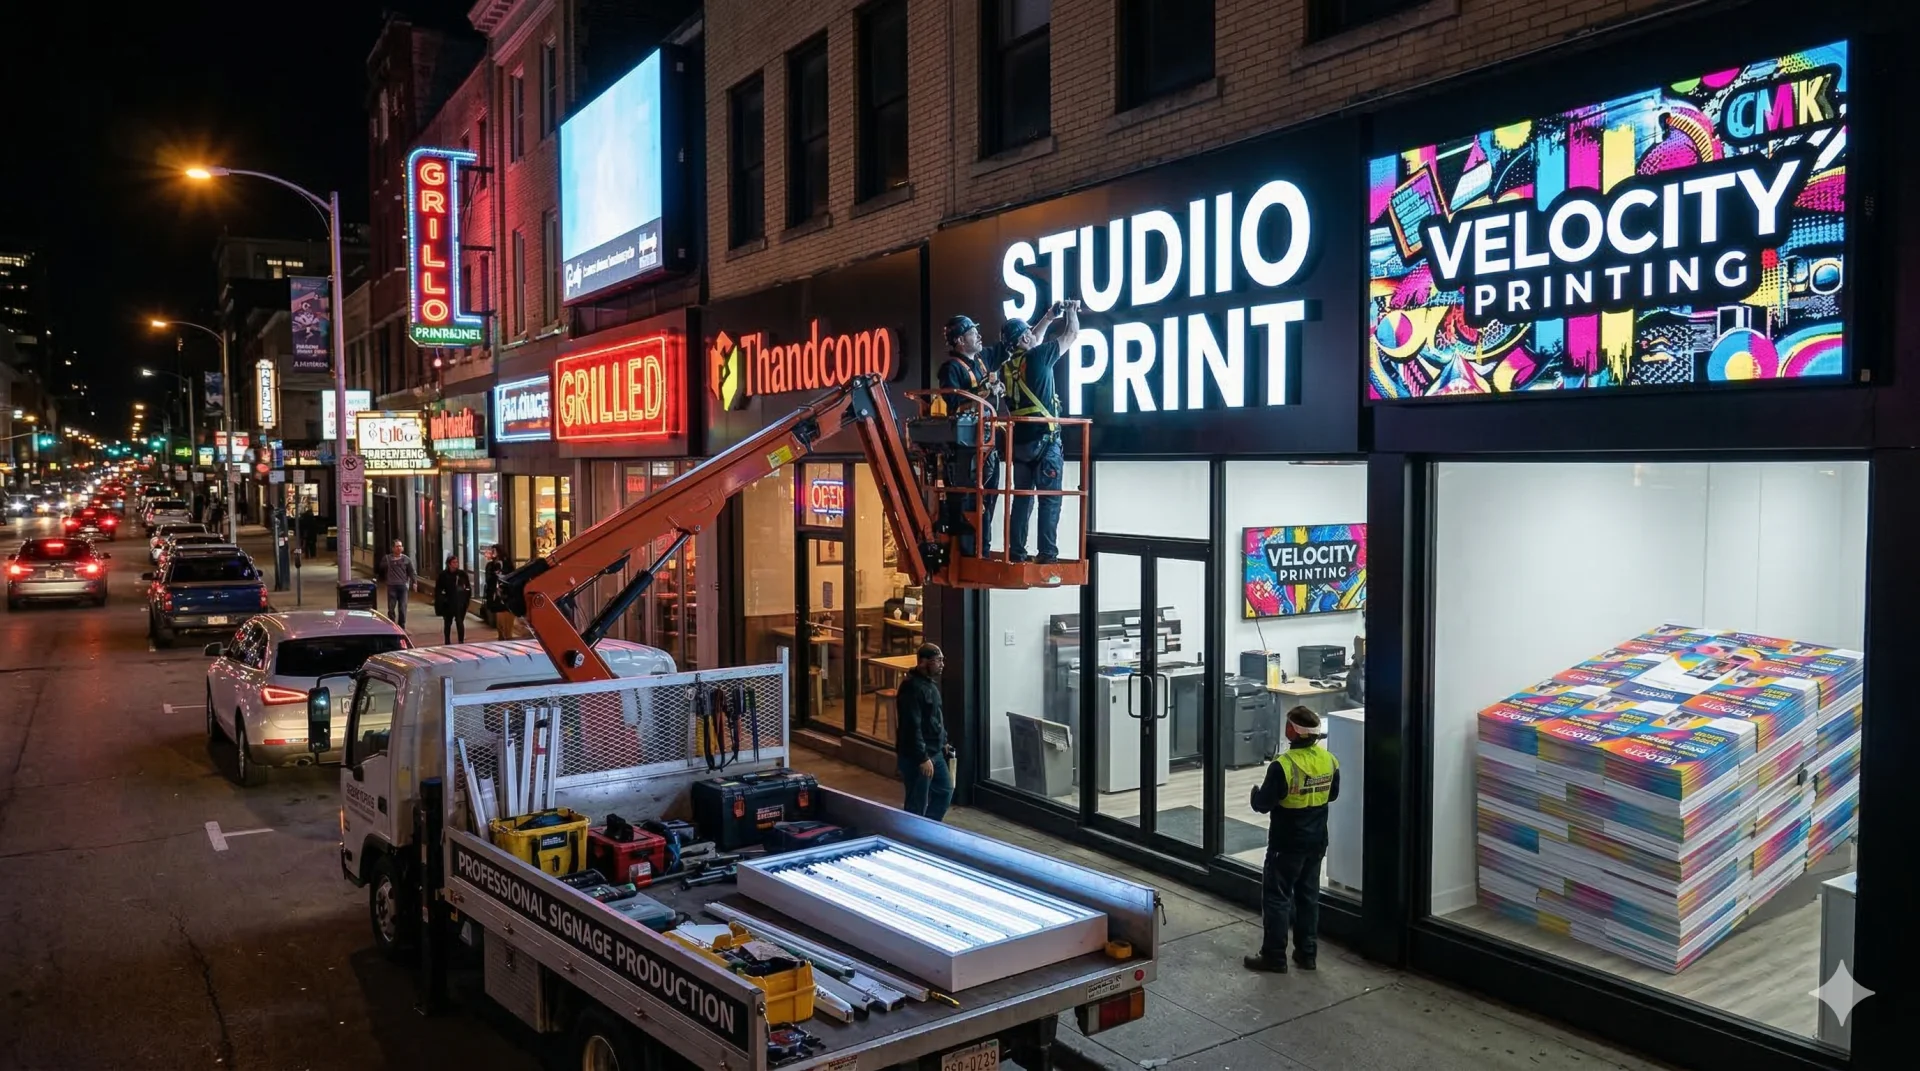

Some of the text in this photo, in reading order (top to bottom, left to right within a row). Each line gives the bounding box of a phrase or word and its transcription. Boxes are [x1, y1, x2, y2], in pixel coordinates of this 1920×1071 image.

[1726, 74, 1829, 139] CMK
[420, 162, 449, 322] GRILLO
[1002, 180, 1311, 321] STUDIIO
[1428, 159, 1800, 280] VELOCITY
[1474, 250, 1749, 316] PRINTING
[559, 355, 663, 427] GRILLED
[1068, 299, 1305, 415] PRINT
[1267, 545, 1357, 566] VELOCITY
[1280, 566, 1347, 581] PRINTING
[458, 851, 735, 1035] PROFESSIONAL SIGNAGE PRODUCTION
